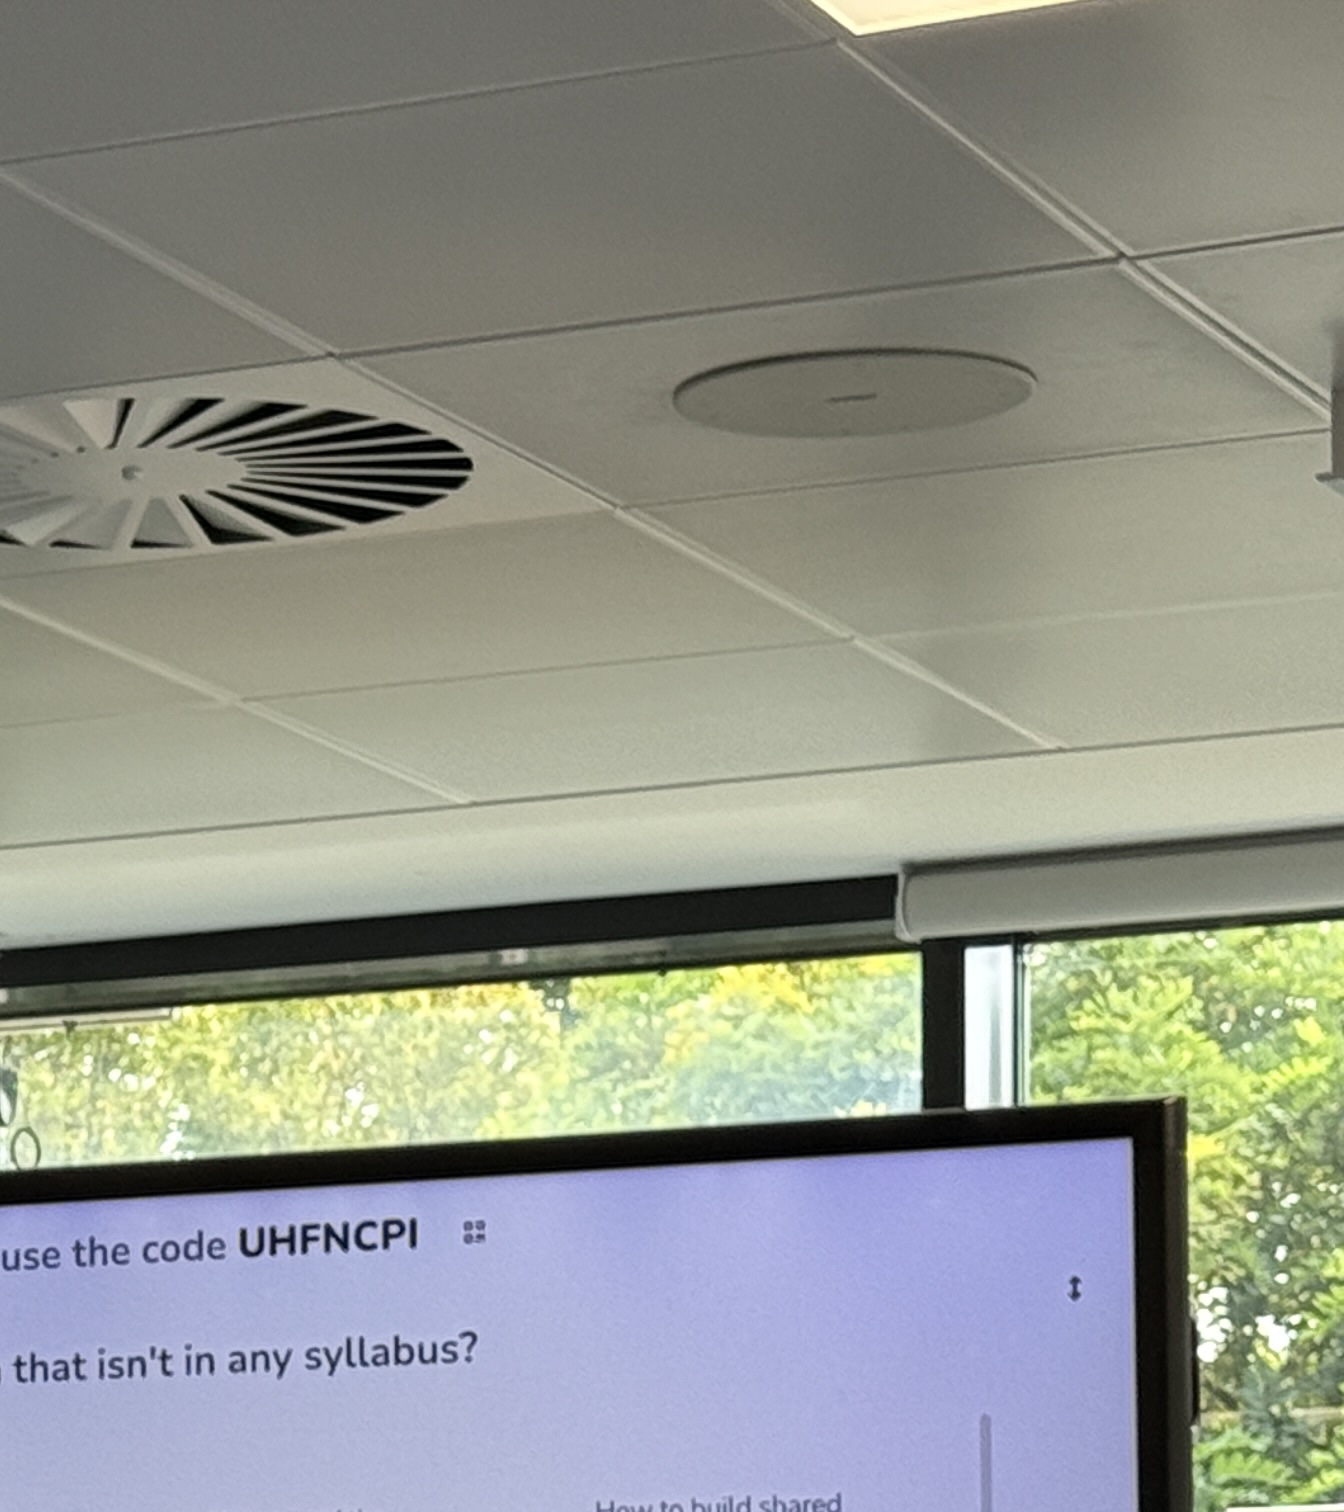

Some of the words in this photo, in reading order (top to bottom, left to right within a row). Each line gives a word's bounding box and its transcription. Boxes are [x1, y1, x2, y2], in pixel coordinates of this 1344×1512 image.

[1, 1246, 61, 1272] use
[71, 1235, 131, 1268] the
[142, 1229, 227, 1264] code
[239, 1217, 418, 1258] UHFNCPI
[12, 1351, 87, 1384] that
[97, 1345, 174, 1381] isn't
[184, 1343, 216, 1376] in
[228, 1349, 293, 1380] any
[305, 1330, 478, 1377] syllabus?
